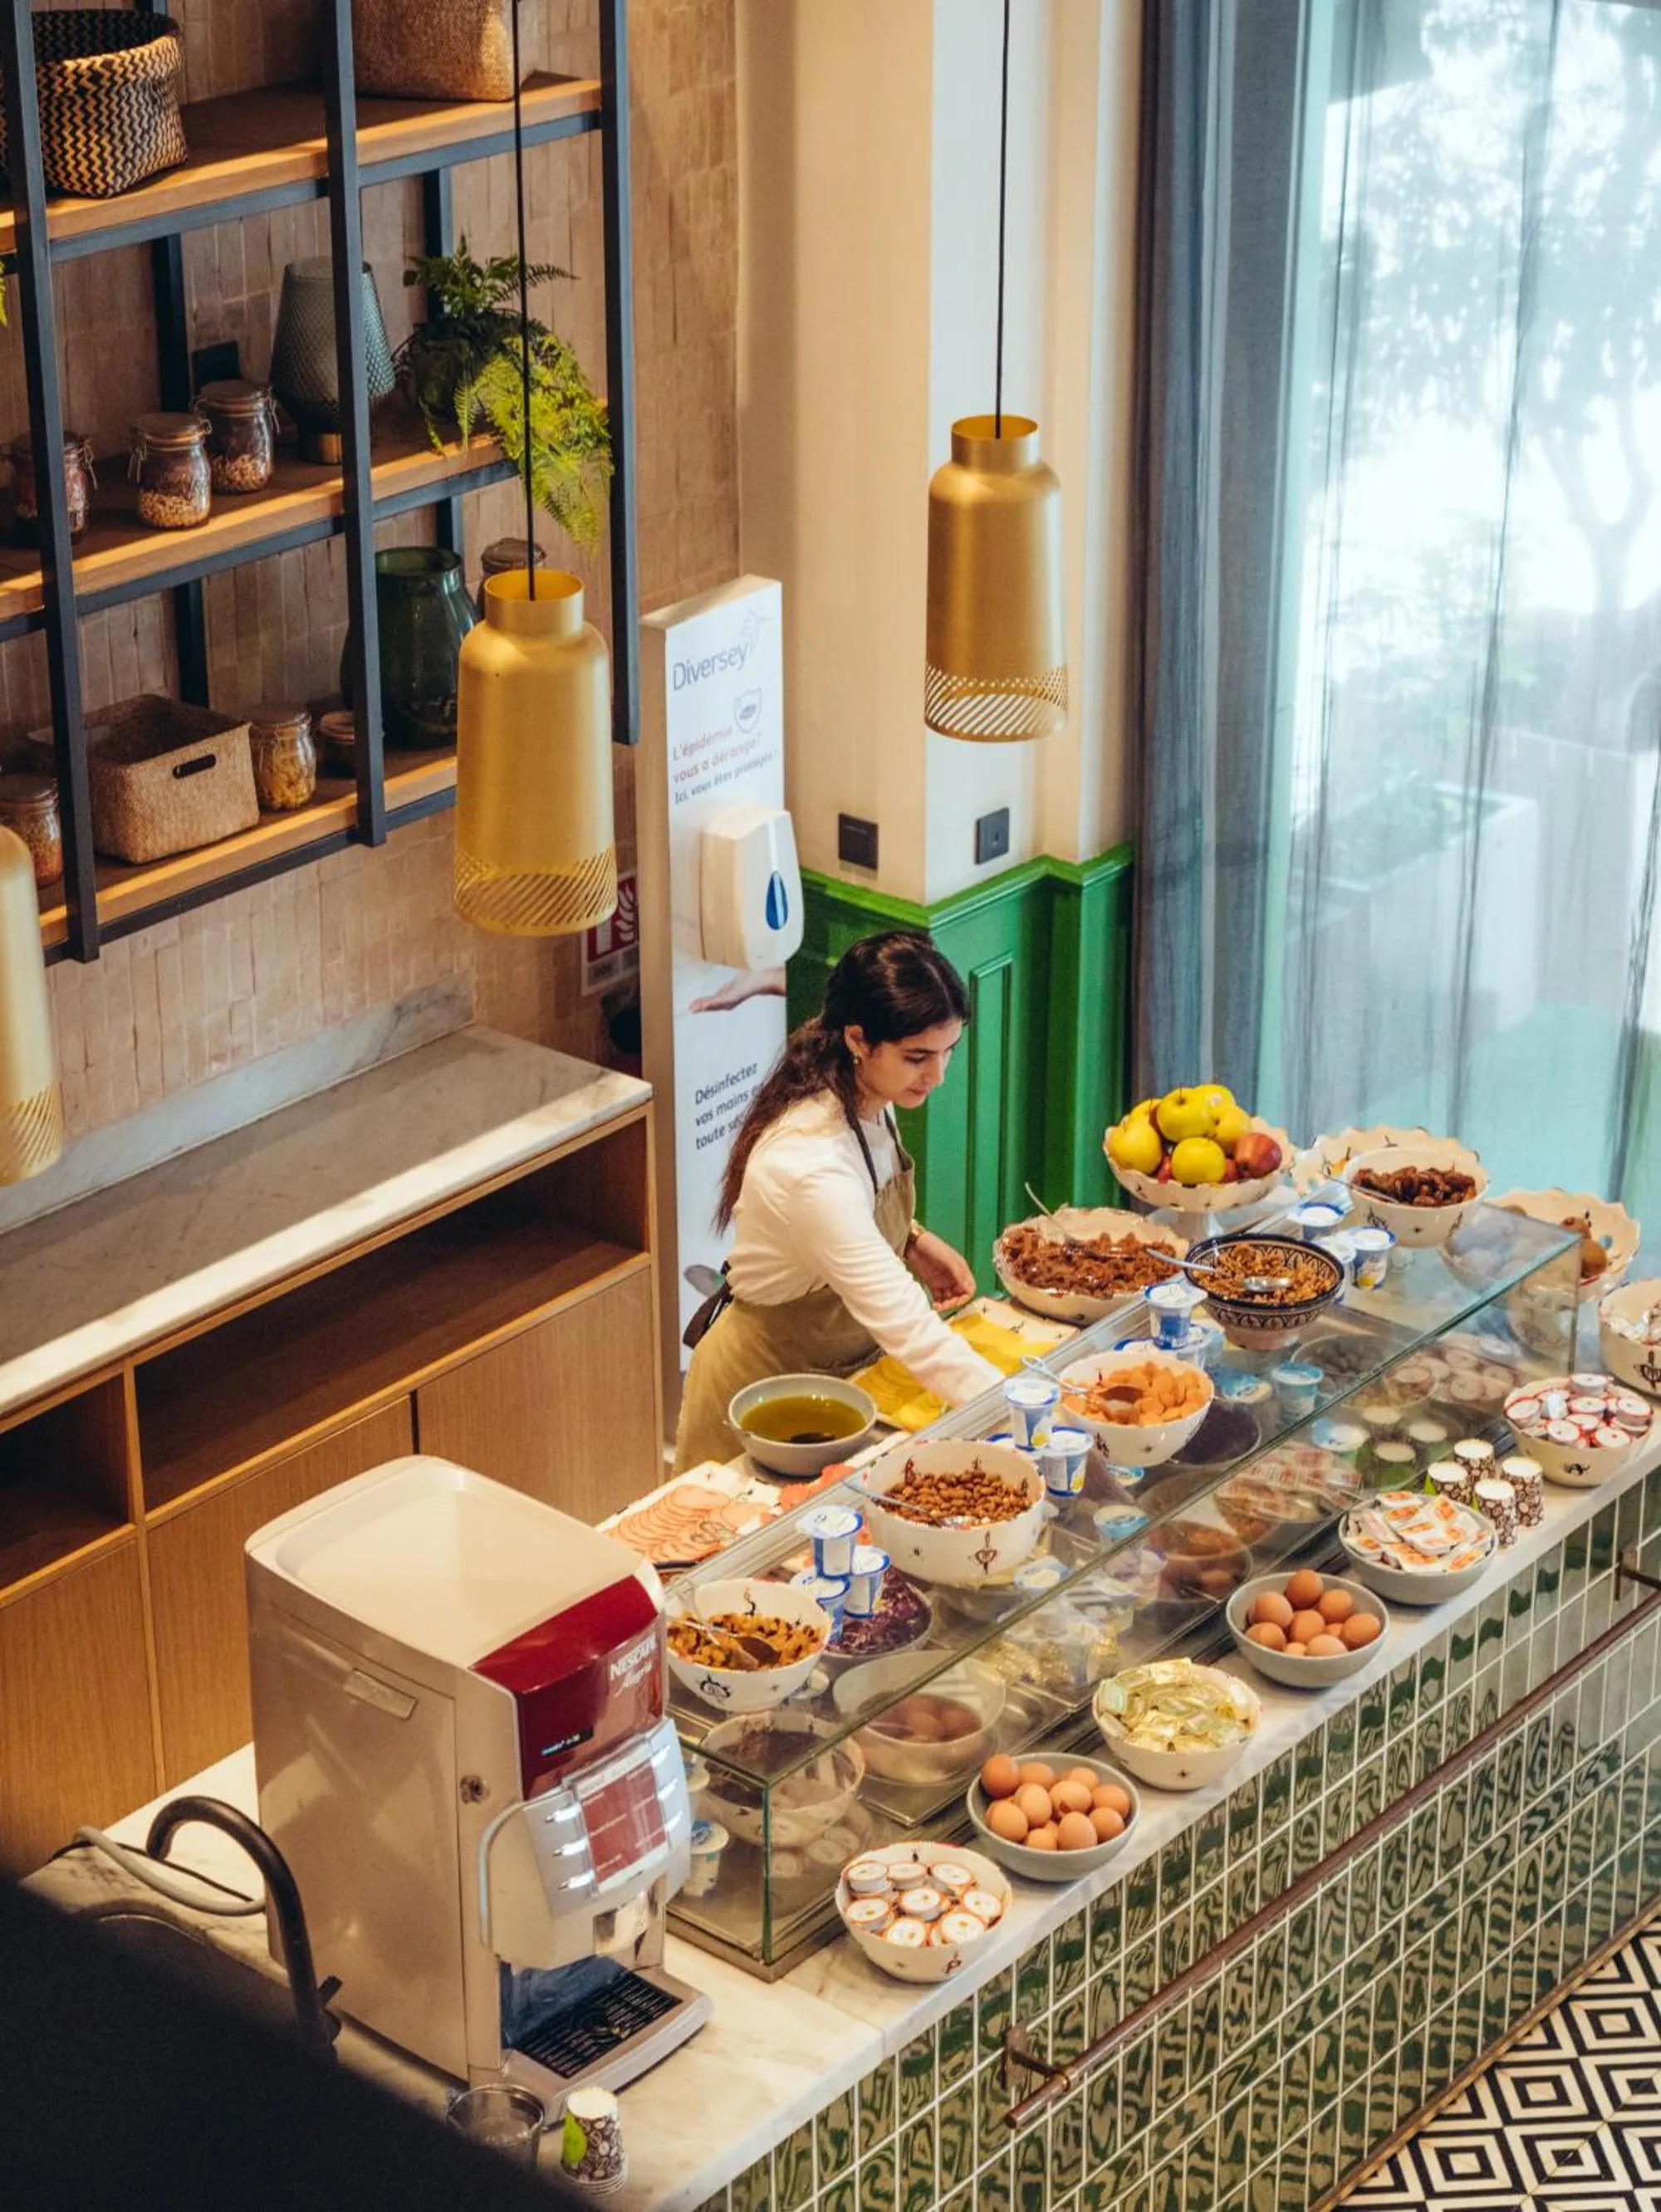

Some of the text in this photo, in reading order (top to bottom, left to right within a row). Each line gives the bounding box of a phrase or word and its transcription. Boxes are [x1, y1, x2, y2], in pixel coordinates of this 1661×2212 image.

[673, 643, 748, 691] Diversey
[674, 764, 699, 784] vous
[695, 1063, 757, 1105] Désinfectez
[696, 1109, 713, 1127] vos
[716, 1089, 749, 1115] mains
[696, 1125, 725, 1150] toute
